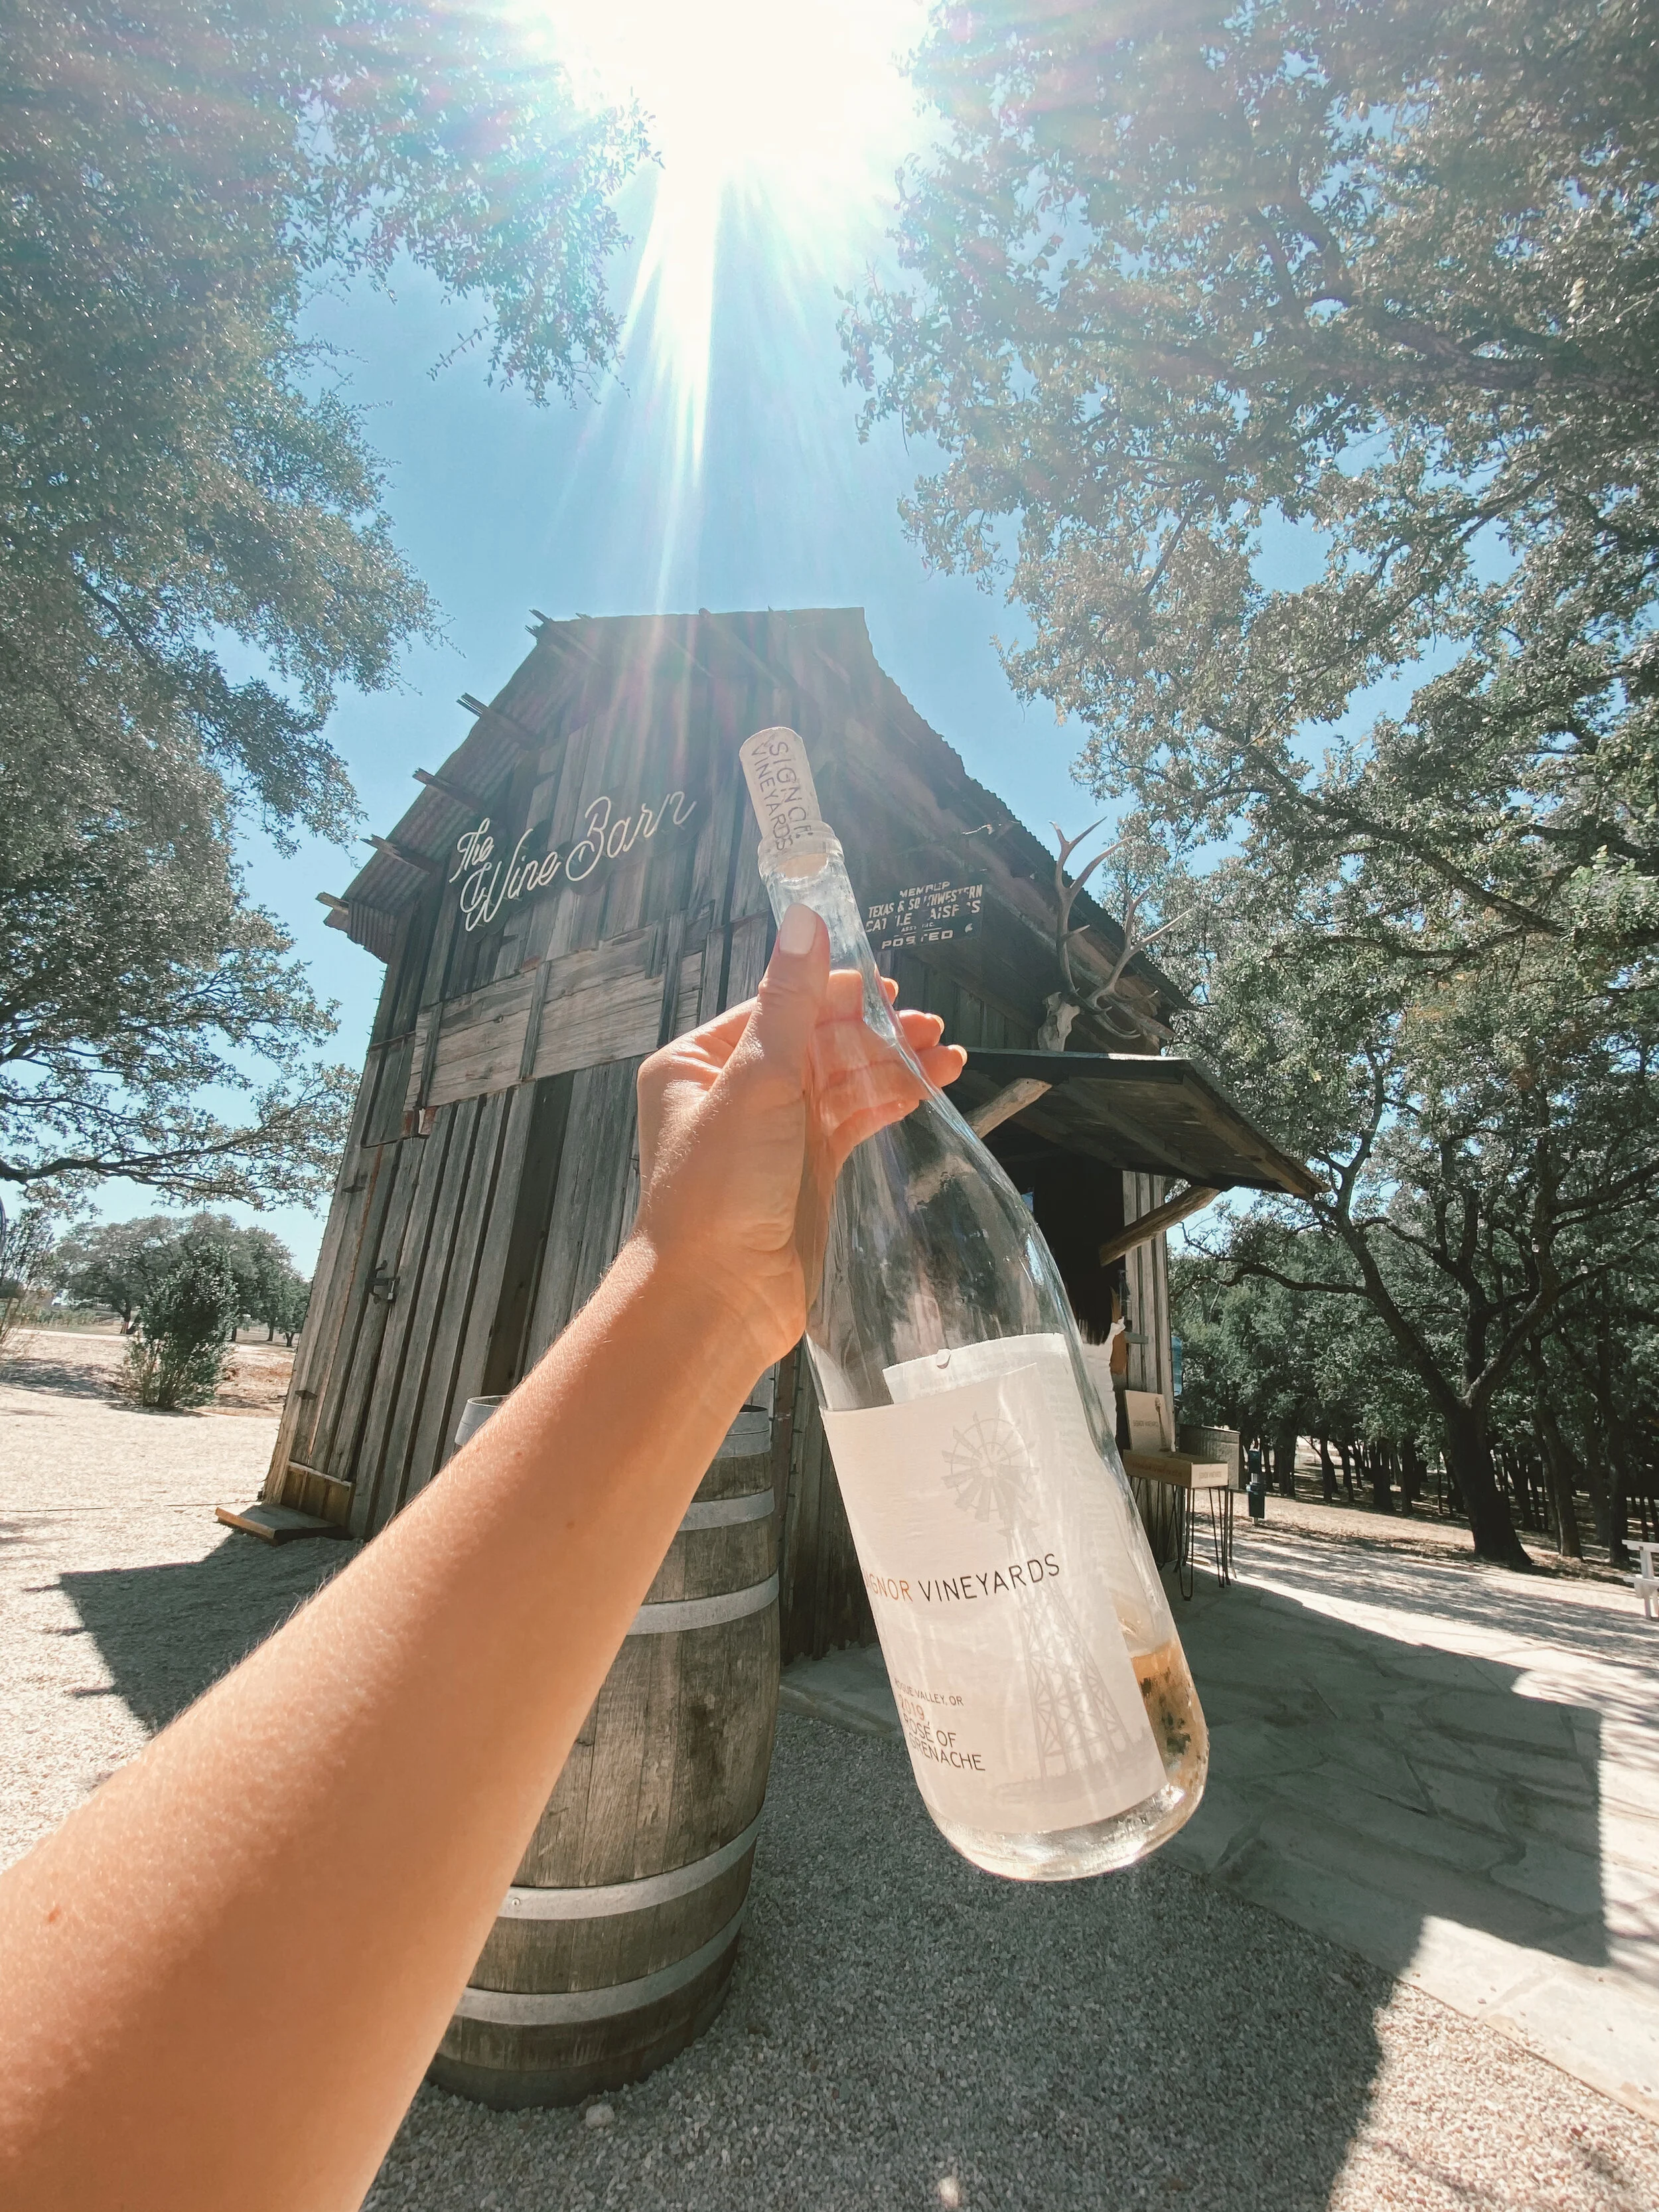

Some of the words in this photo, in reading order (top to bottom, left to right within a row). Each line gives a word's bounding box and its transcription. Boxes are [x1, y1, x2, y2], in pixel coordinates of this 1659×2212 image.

[751, 742, 793, 851] VINEYARDS
[449, 817, 495, 883] The
[460, 828, 562, 932] Wine
[565, 790, 697, 881] Barn
[869, 902, 895, 919] TEXAS
[897, 900, 905, 913] &
[908, 884, 983, 911] SOHWESRN
[865, 913, 912, 933] CATLE
[918, 1553, 1060, 1602] VINEYARDS
[899, 1694, 924, 1721] 2019
[949, 1696, 964, 1706] OR
[908, 1732, 986, 1771] GRENACHE
[936, 1730, 956, 1748] OF
